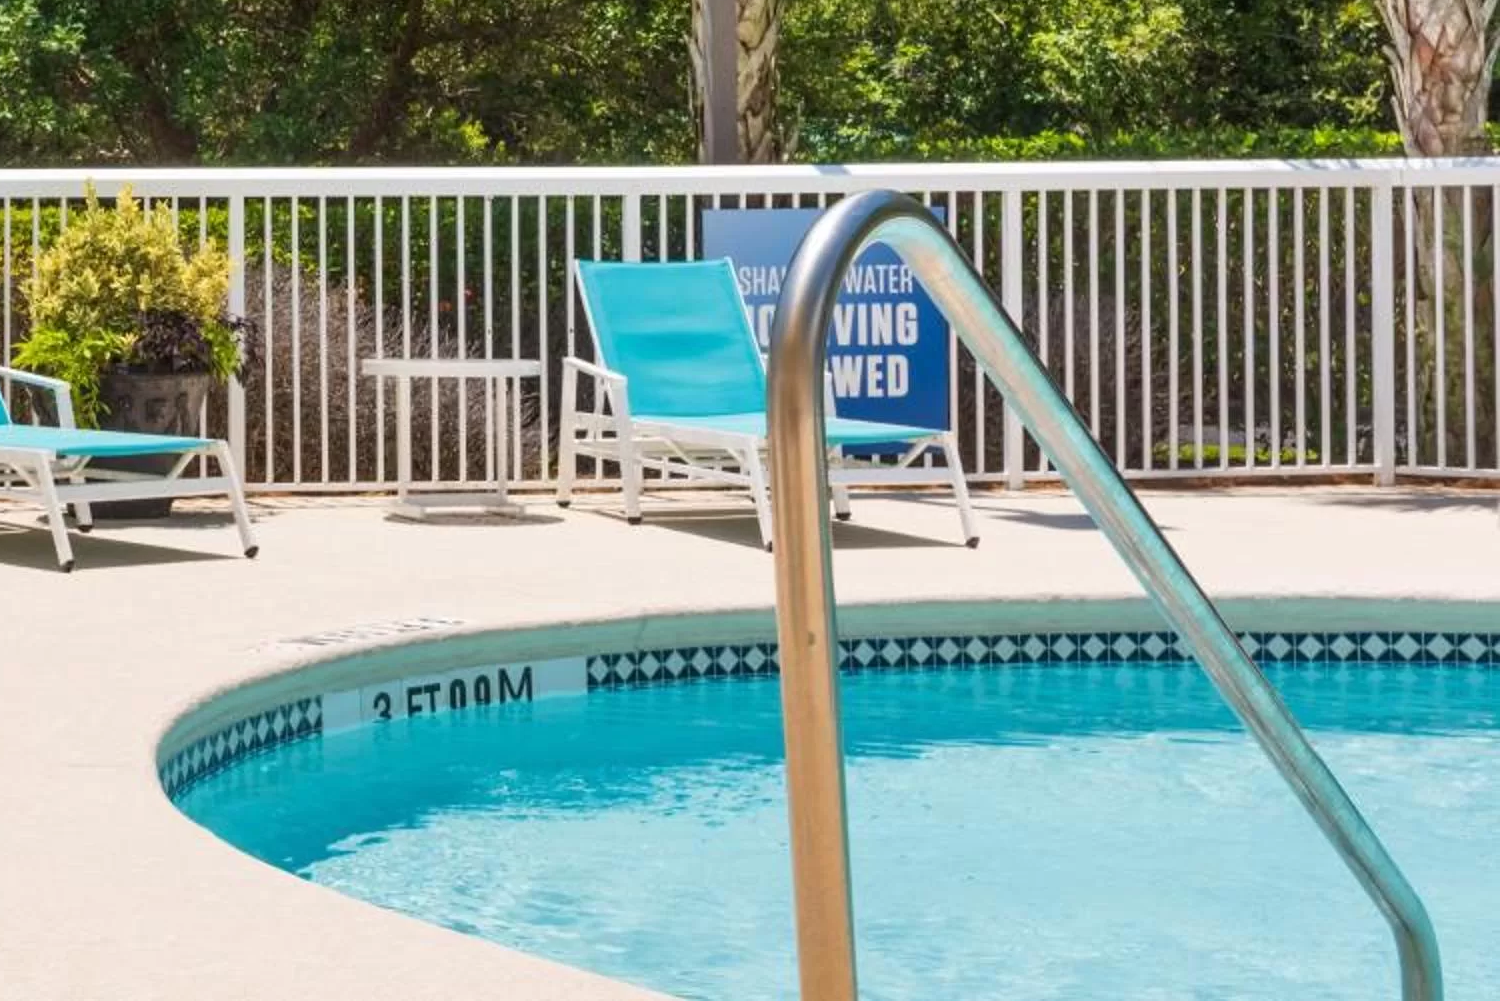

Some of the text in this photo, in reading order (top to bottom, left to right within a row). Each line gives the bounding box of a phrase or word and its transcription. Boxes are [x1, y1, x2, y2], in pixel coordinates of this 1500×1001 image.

[843, 264, 913, 295] WATER
[831, 302, 919, 346] VING
[406, 682, 441, 718] FT
